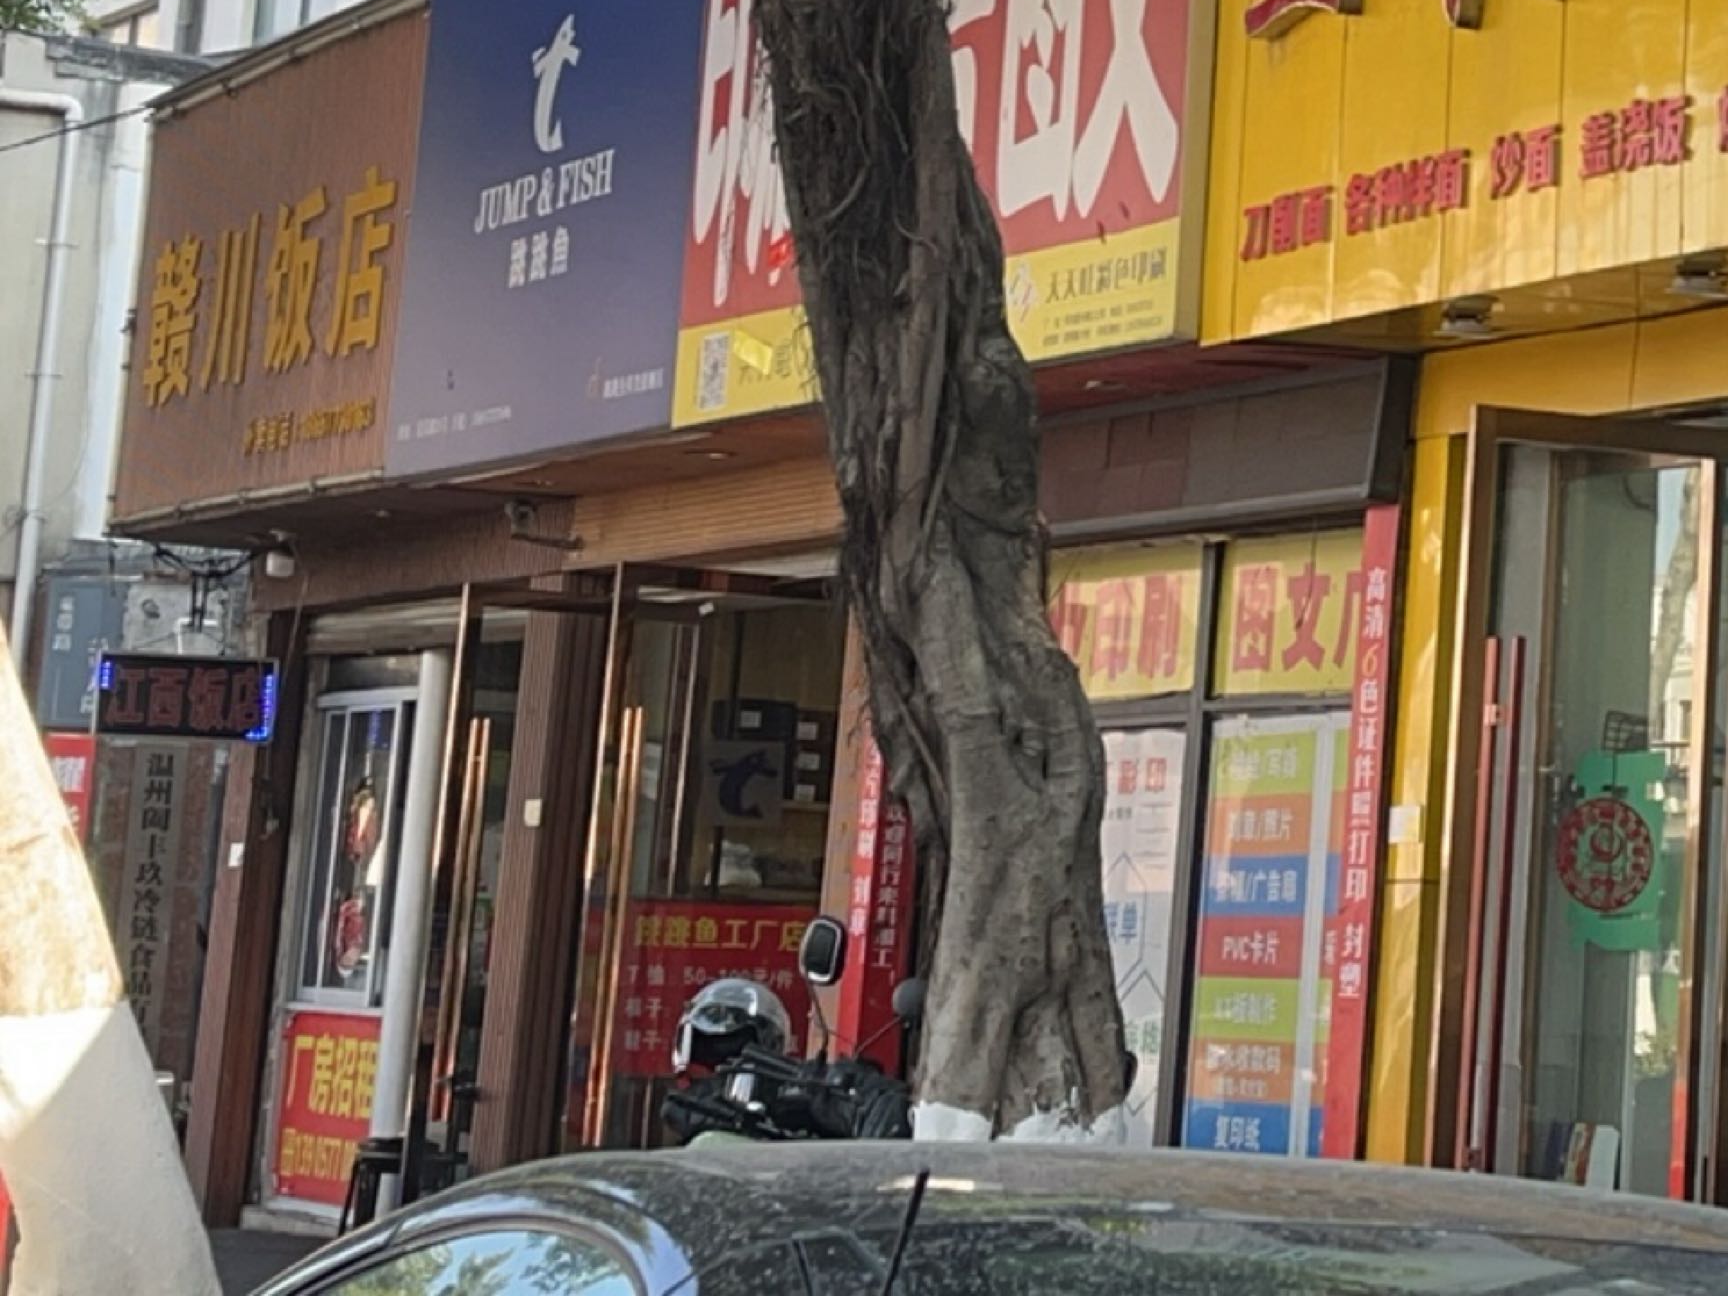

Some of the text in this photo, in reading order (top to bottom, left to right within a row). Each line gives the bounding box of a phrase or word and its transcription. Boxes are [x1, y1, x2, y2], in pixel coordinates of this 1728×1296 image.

[474, 149, 615, 234] JUMP & FISH
[1240, 185, 1333, 261] 刀削面
[1489, 123, 1562, 201] 炒面
[1579, 95, 1692, 181] 盖浇饭
[143, 165, 398, 407] 赣川饭店
[105, 665, 262, 732] 江西饭店
[1221, 929, 1281, 966] PVC卡片
